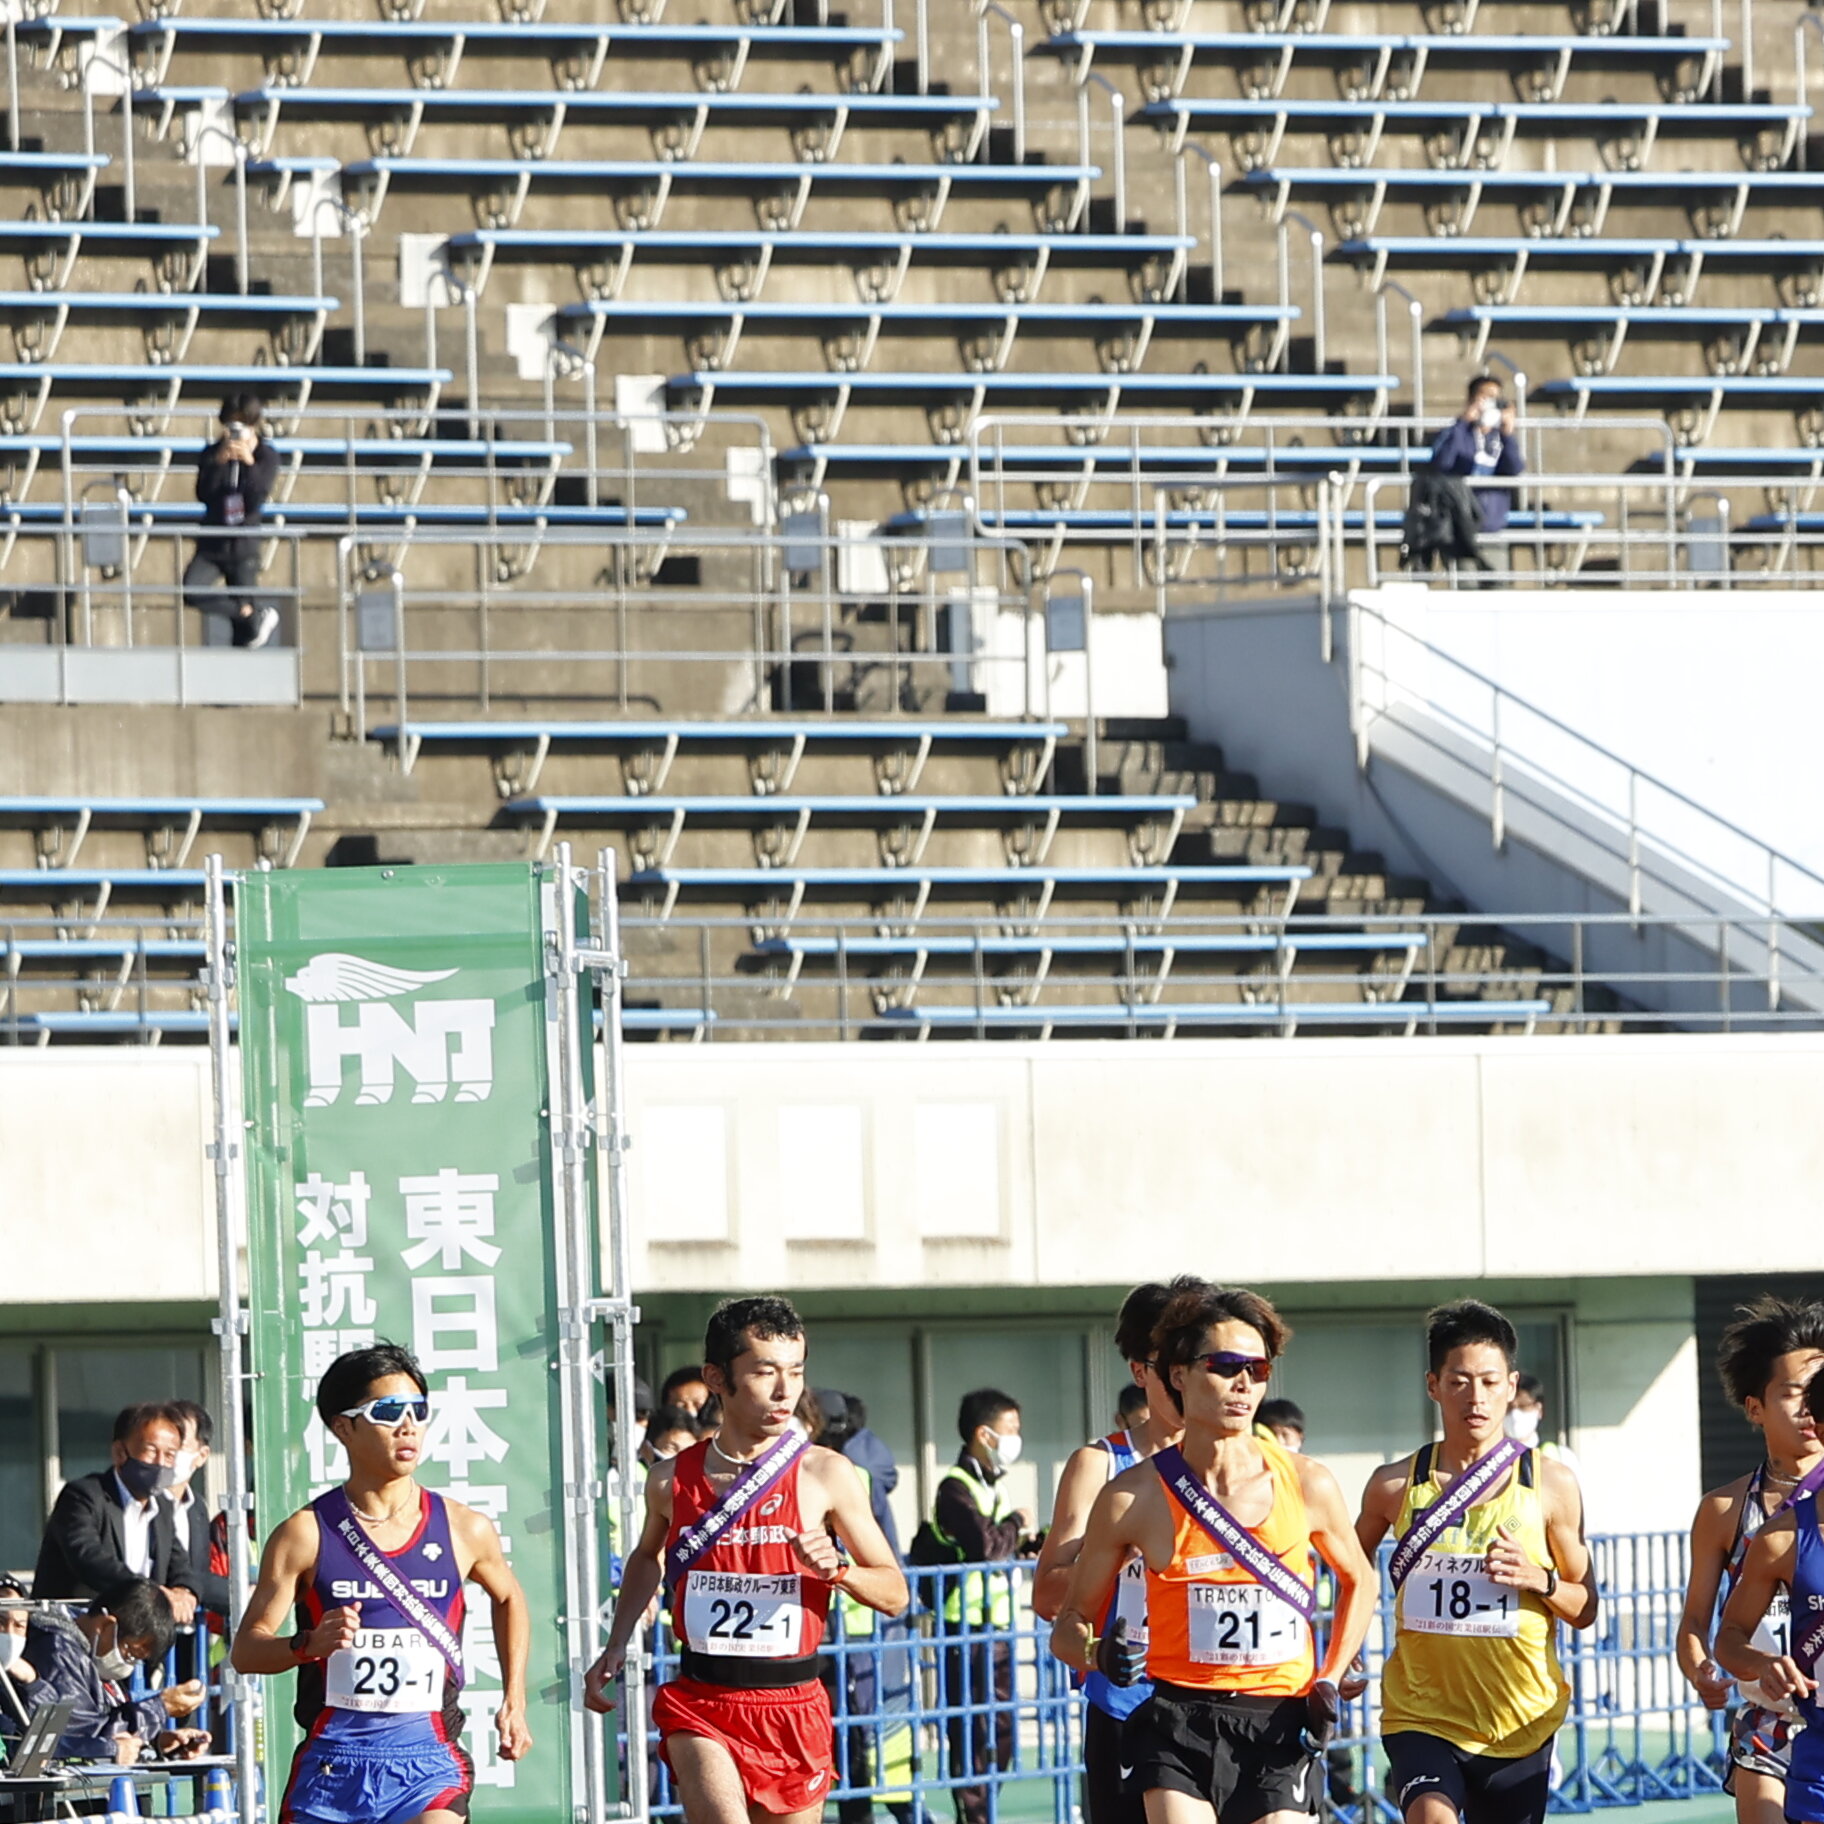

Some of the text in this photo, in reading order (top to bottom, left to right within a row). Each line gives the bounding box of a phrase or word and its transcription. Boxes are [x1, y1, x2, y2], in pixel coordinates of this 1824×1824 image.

[691, 1577, 798, 1595] JP日本郵政グループ東京
[1194, 1588, 1250, 1604] TRACK
[1429, 1579, 1508, 1620] 18-1
[709, 1599, 791, 1640] 22-1
[1218, 1611, 1297, 1649] 21-1
[354, 1655, 434, 1696] 23-1
